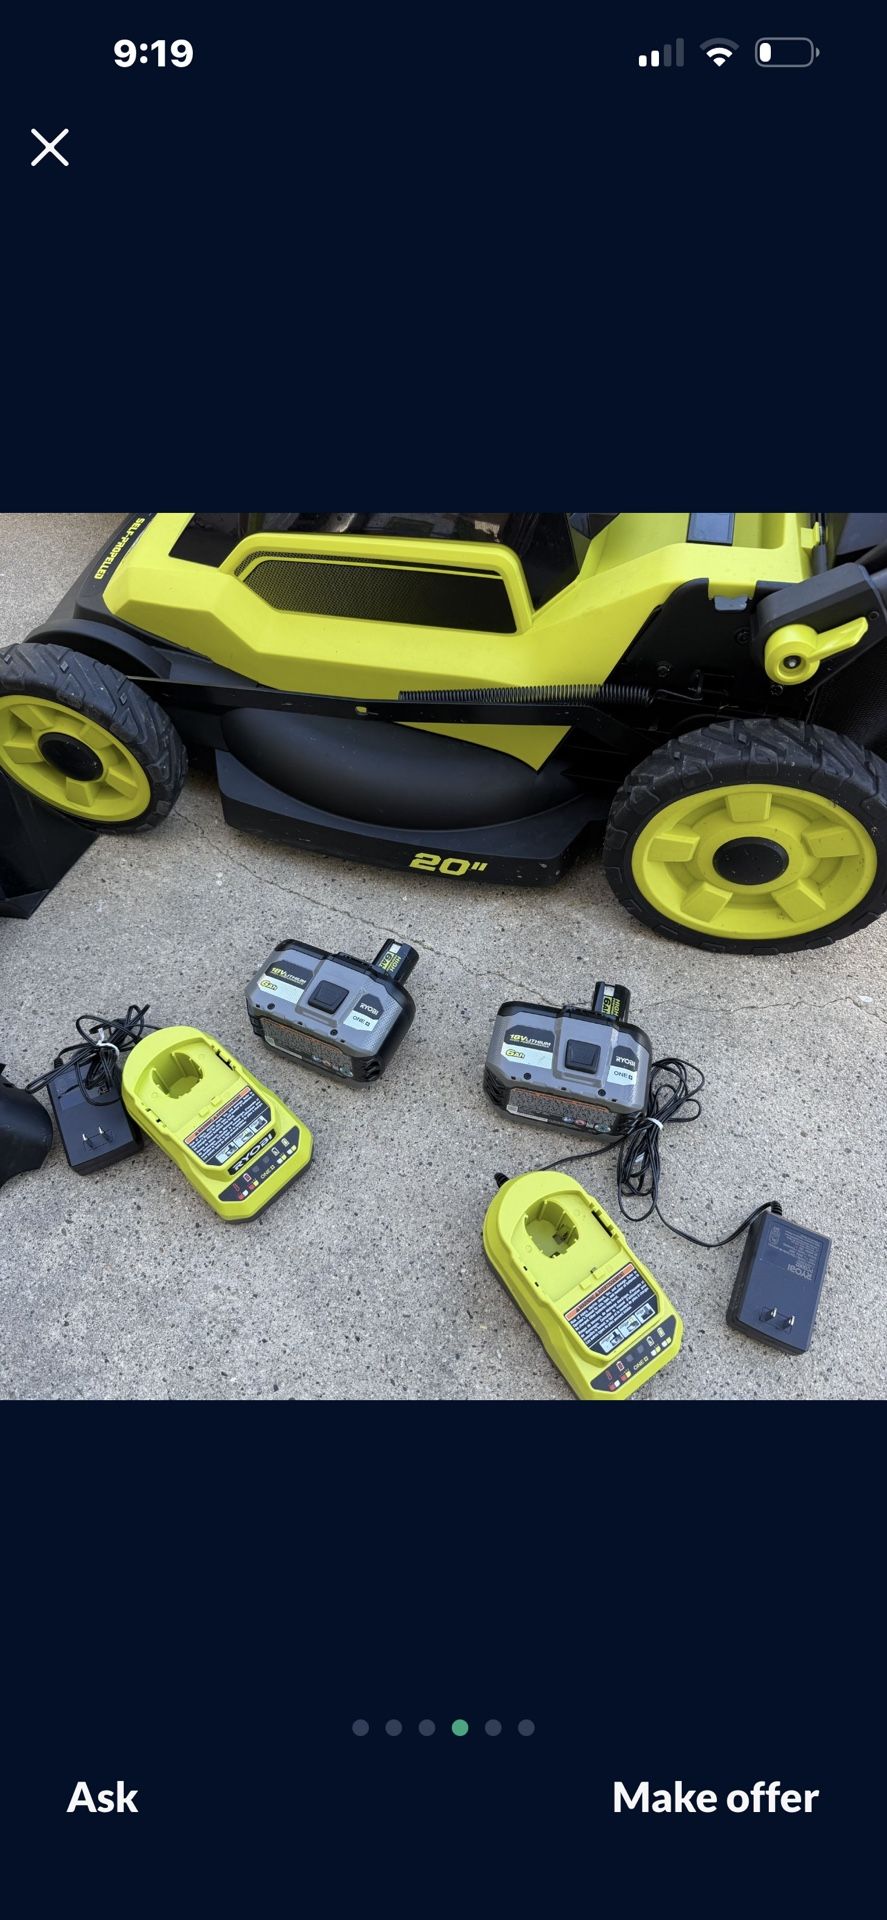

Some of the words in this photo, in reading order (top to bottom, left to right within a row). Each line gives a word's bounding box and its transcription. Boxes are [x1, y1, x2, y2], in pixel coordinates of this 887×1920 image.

[94, 517, 145, 579] SELF-PROPELLED
[409, 852, 488, 876] 20"
[359, 1002, 380, 1016] RYOBI
[615, 1055, 636, 1067] RYOBI
[233, 1133, 273, 1171] RYOBI
[787, 1263, 813, 1281] RYOBI
